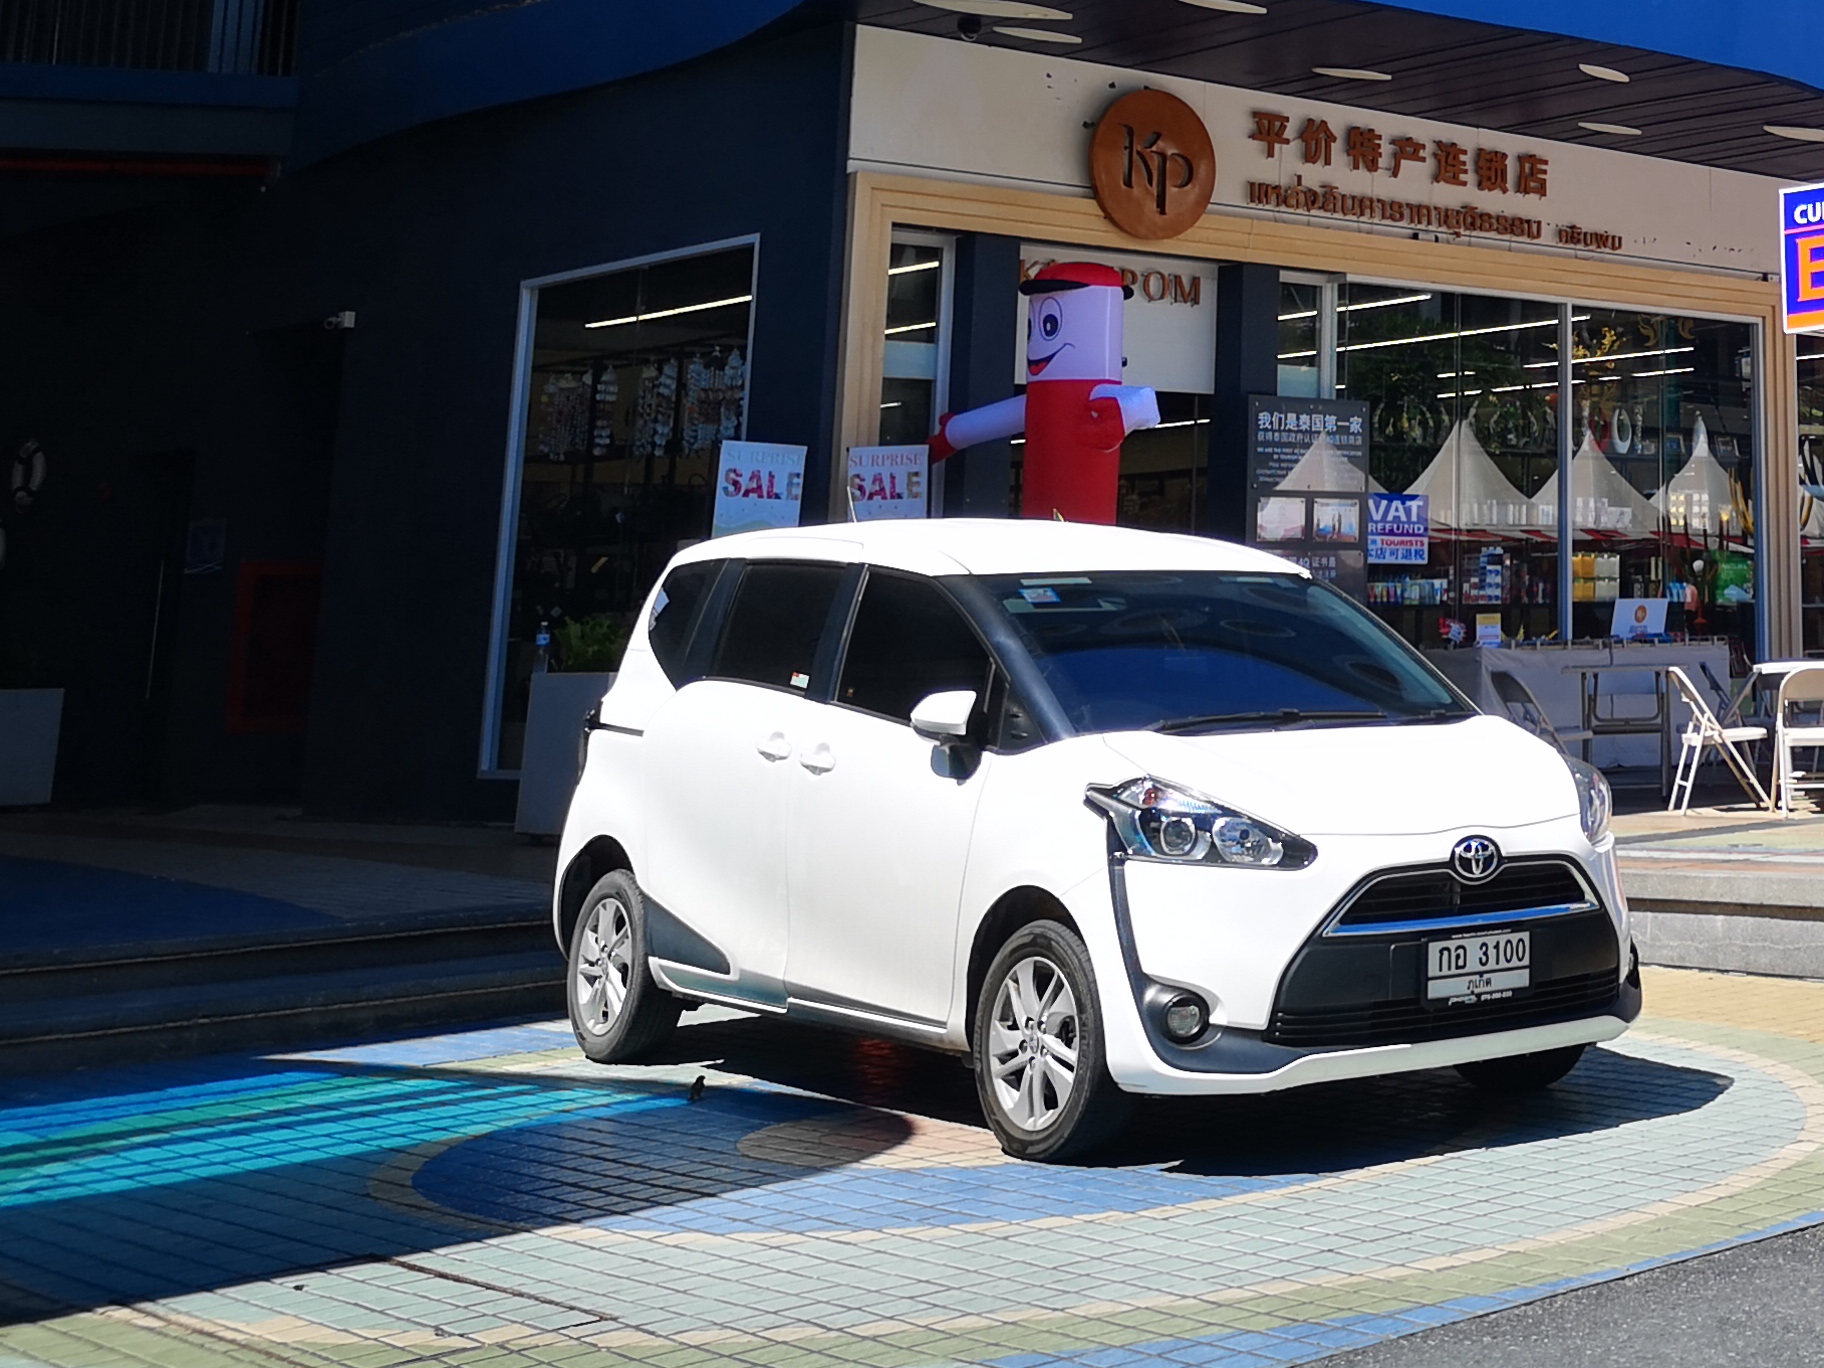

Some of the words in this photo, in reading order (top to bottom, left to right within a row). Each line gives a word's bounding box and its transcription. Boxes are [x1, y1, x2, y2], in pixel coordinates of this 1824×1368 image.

[1252, 111, 1549, 198] 平价特产连锁店
[1258, 412, 1363, 433] 我们是泰国第一家
[850, 452, 923, 468] SURPRISE
[722, 467, 801, 500] SALE
[850, 471, 923, 501] SALE
[1368, 499, 1424, 522] VAT
[1368, 523, 1424, 534] REFUND
[1380, 539, 1425, 547] TOURISTS
[1438, 945, 1467, 973] กอ
[1479, 937, 1526, 967] 3100
